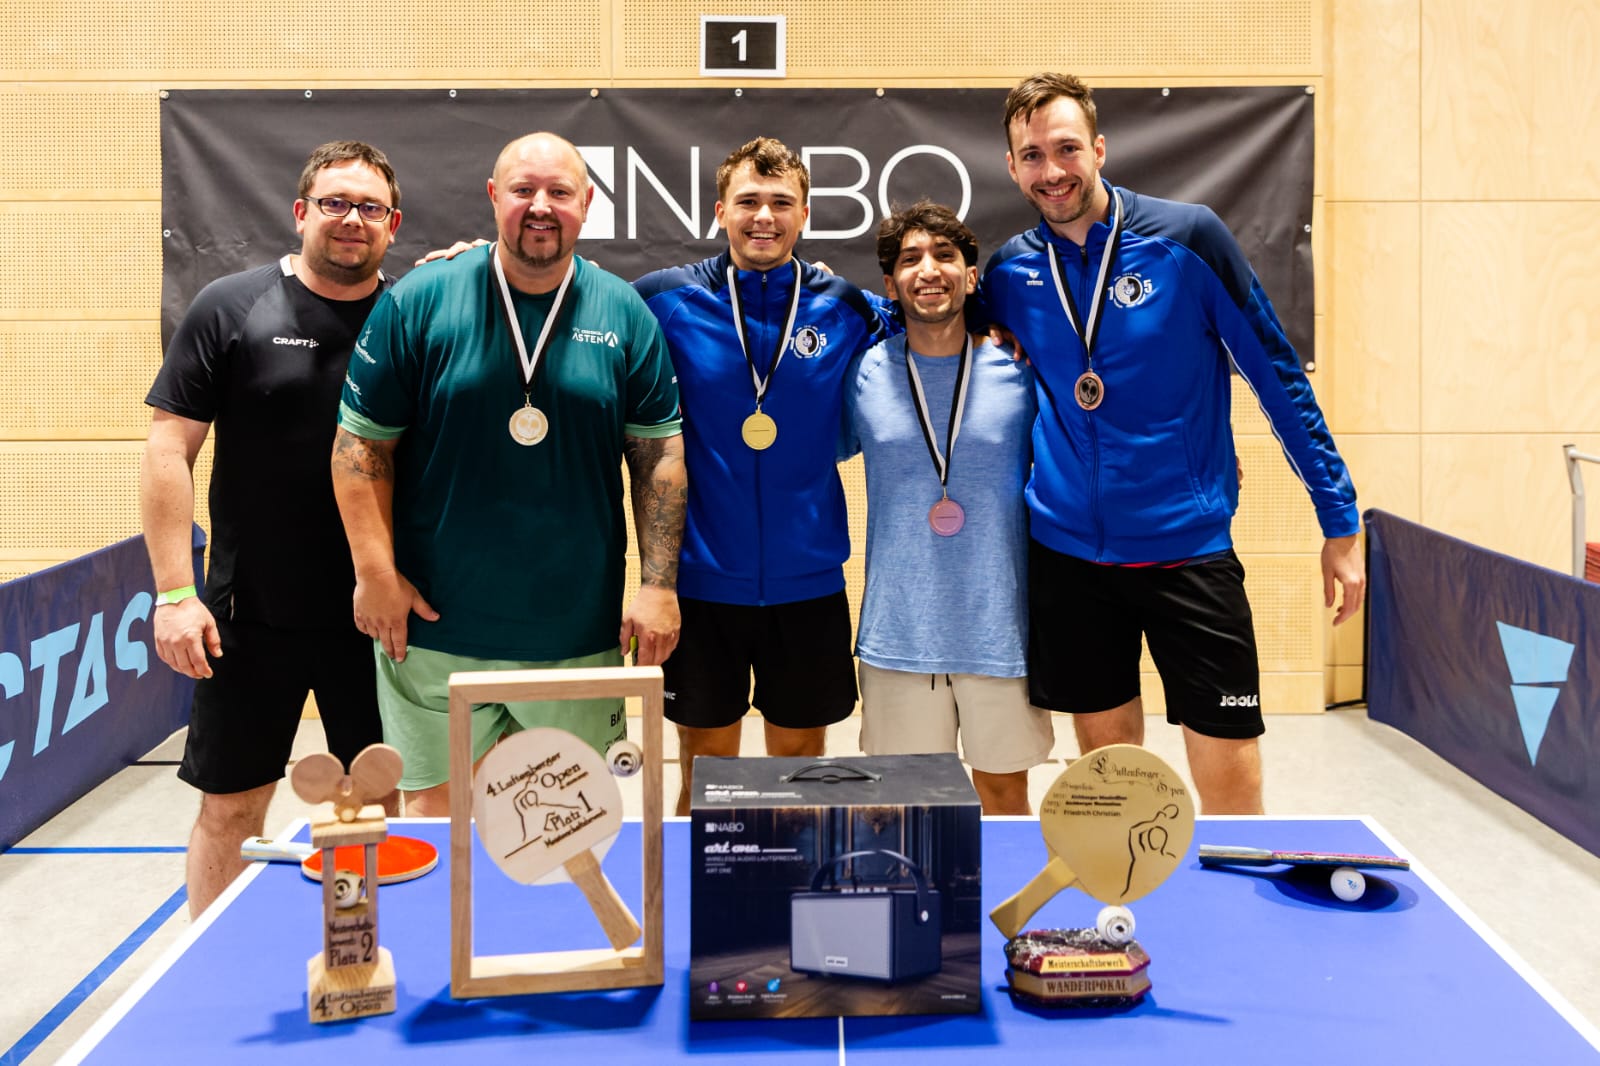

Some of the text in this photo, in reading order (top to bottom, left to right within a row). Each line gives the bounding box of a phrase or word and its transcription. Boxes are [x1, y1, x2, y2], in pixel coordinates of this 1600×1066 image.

[731, 29, 747, 61] 1
[627, 144, 972, 240] NBO
[273, 336, 309, 346] CRAFT
[572, 332, 604, 344] ASTEN
[1220, 694, 1258, 707] JOOLA
[541, 763, 581, 789] Open
[550, 790, 593, 831] Platz 1
[715, 822, 744, 832] NABO
[329, 931, 373, 967] Platz 2
[1046, 978, 1128, 993] WANDERPOKAL
[341, 1000, 382, 1015] Open
